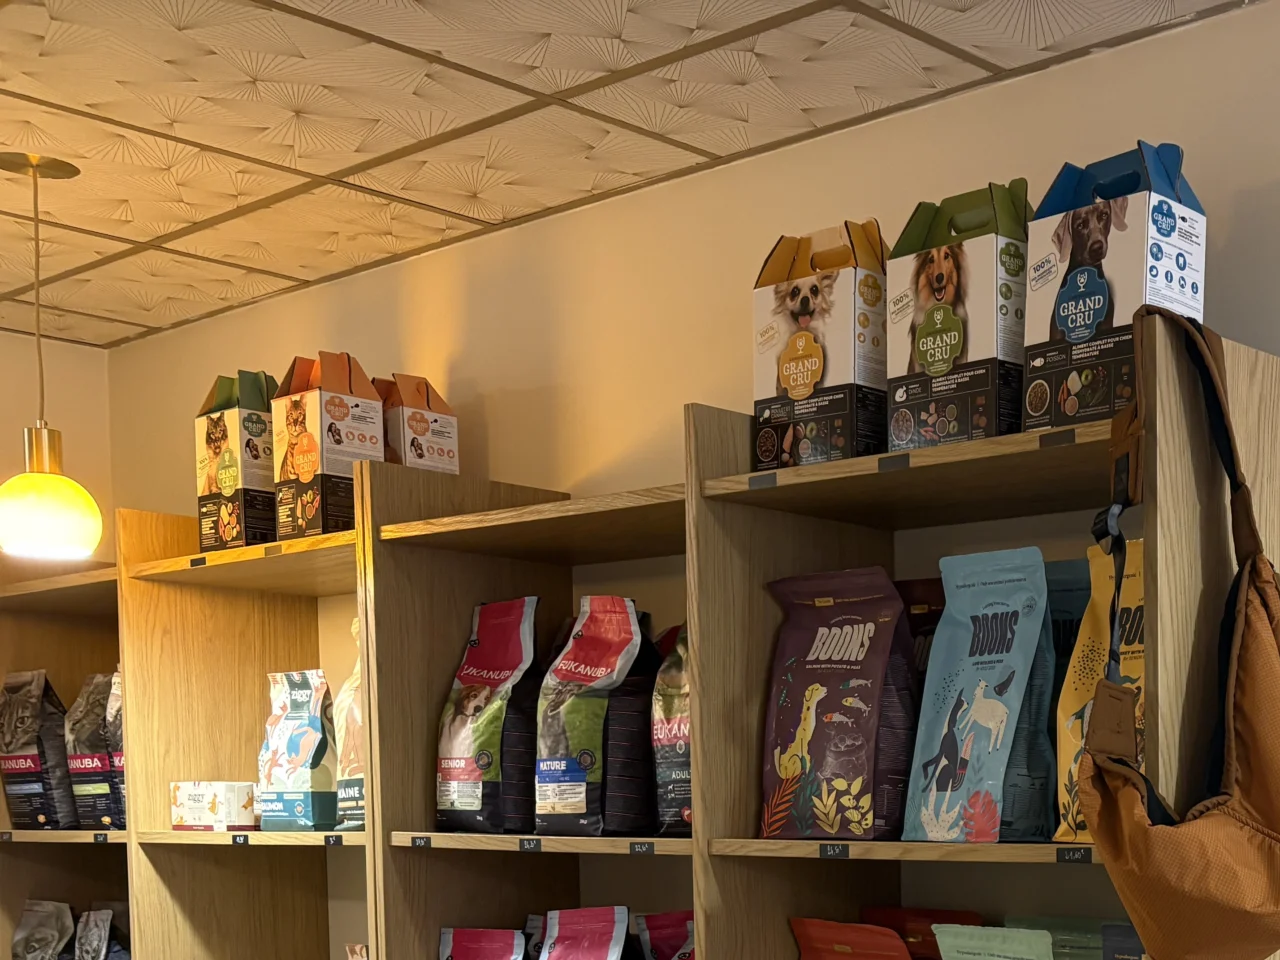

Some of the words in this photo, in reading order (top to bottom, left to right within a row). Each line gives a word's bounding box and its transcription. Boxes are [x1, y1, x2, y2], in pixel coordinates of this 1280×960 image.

[1060, 294, 1104, 316] GRAND
[1068, 310, 1094, 328] CRU
[920, 332, 958, 350] GRAND
[927, 348, 950, 362] CRU
[784, 358, 820, 374] GRAND
[790, 372, 812, 386] CRU
[806, 622, 876, 662] BOONS
[968, 610, 1020, 658] BOONS
[291, 688, 312, 703] ziggy
[442, 758, 465, 769] SENIOR
[540, 761, 567, 772] NATURE
